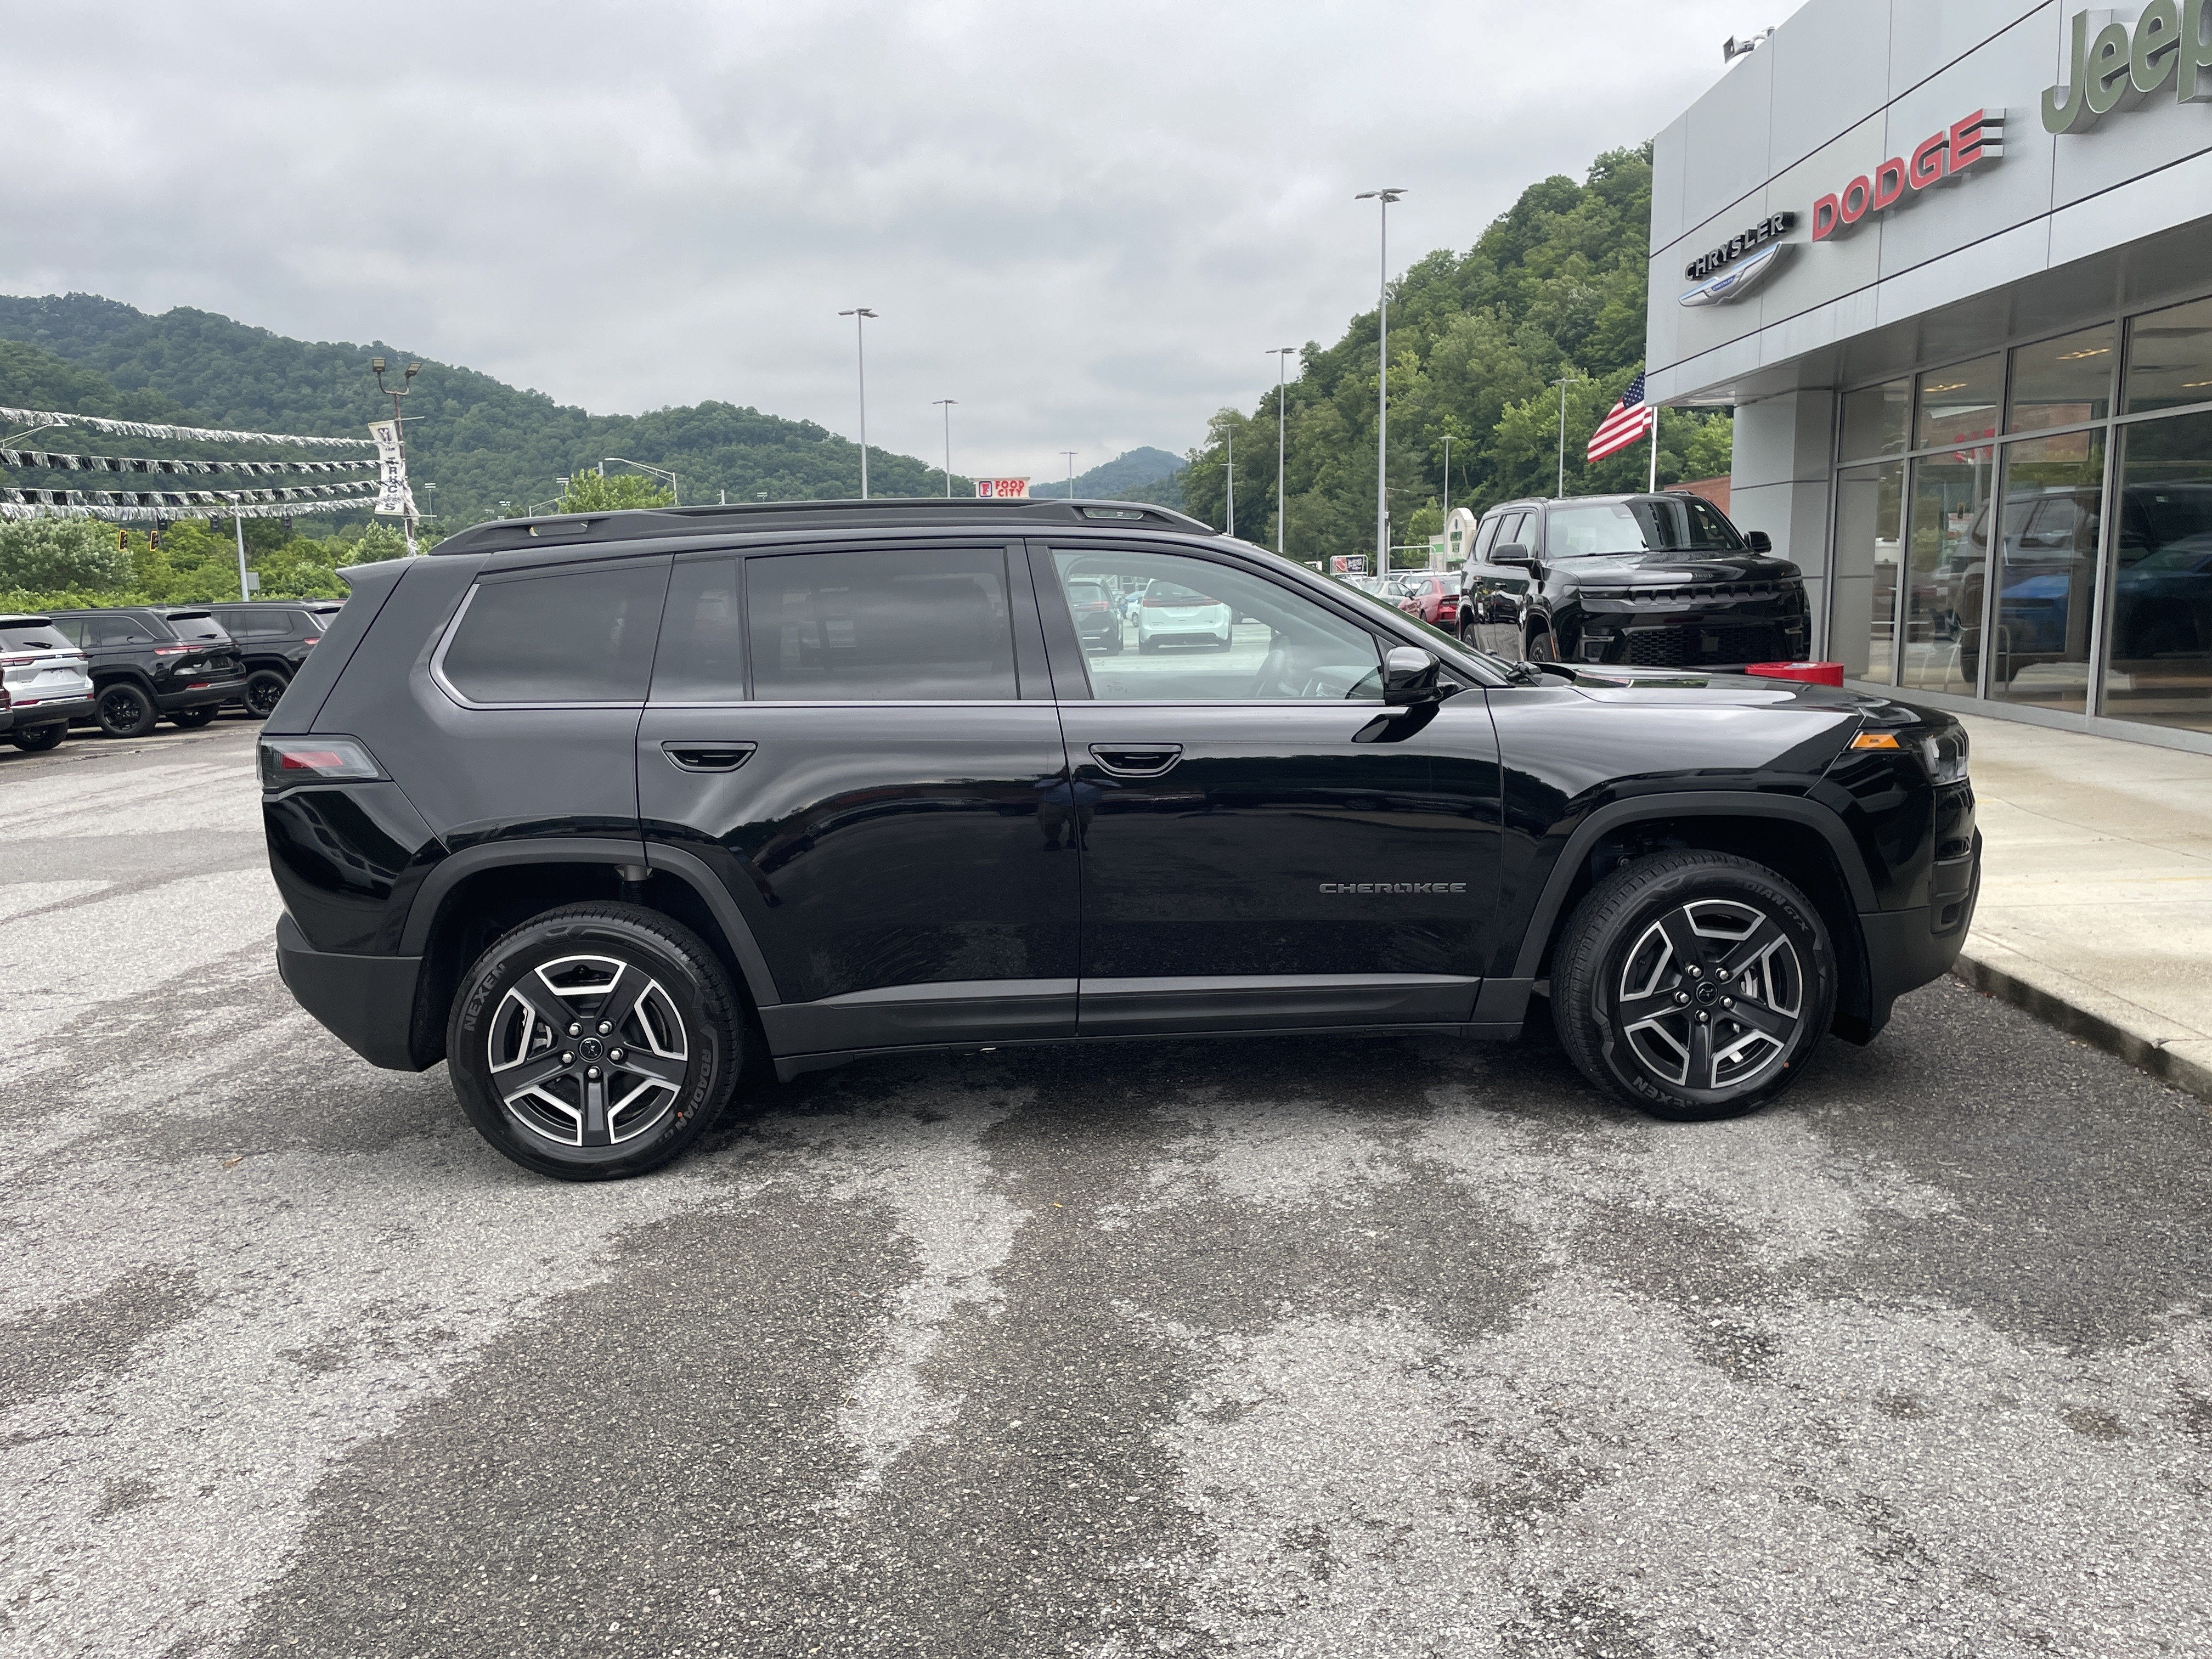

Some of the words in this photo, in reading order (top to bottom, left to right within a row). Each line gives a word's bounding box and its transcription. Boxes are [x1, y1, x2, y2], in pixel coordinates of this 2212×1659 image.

[1812, 108, 1984, 242] DODGE
[1685, 211, 1784, 281] CHRYSLER
[384, 457, 398, 510] TRCS
[995, 480, 1024, 489] FOOD
[998, 488, 1023, 497] CITY
[1319, 882, 1466, 894] CHEROKEE
[1783, 905, 1809, 932] GTX
[463, 963, 506, 1031] NEXEN
[674, 1048, 712, 1132] ROADIAN
